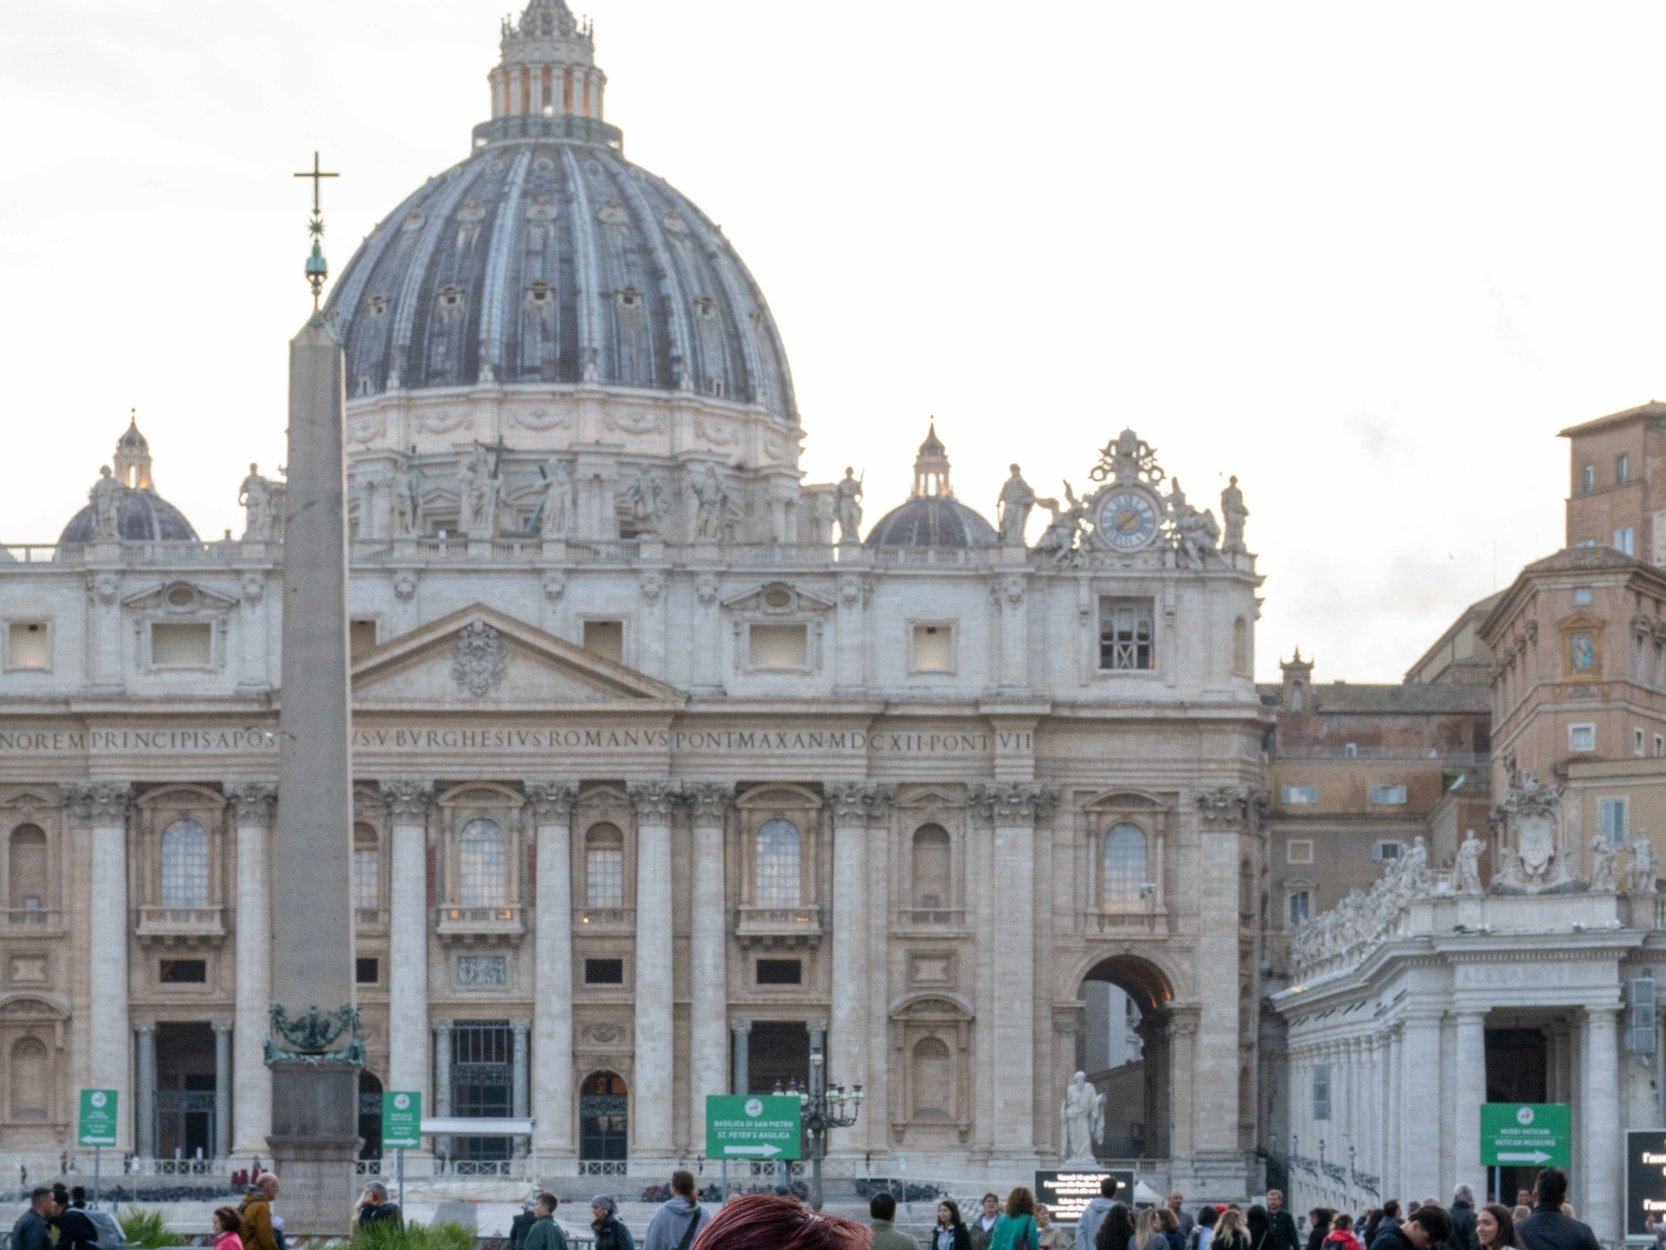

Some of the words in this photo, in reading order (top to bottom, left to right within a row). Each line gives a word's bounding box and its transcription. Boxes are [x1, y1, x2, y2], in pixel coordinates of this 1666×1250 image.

[91, 731, 210, 749] PRINCIPIS
[395, 730, 542, 747] BVRGHESIVS
[549, 730, 669, 748] ROMANVS
[675, 732, 736, 749] PONT
[929, 733, 992, 751] PONT
[999, 732, 1031, 750] VII
[769, 1120, 794, 1128] PIETRO
[758, 1131, 790, 1139] BASILICA
[1523, 1139, 1556, 1147] MUSEUMS
